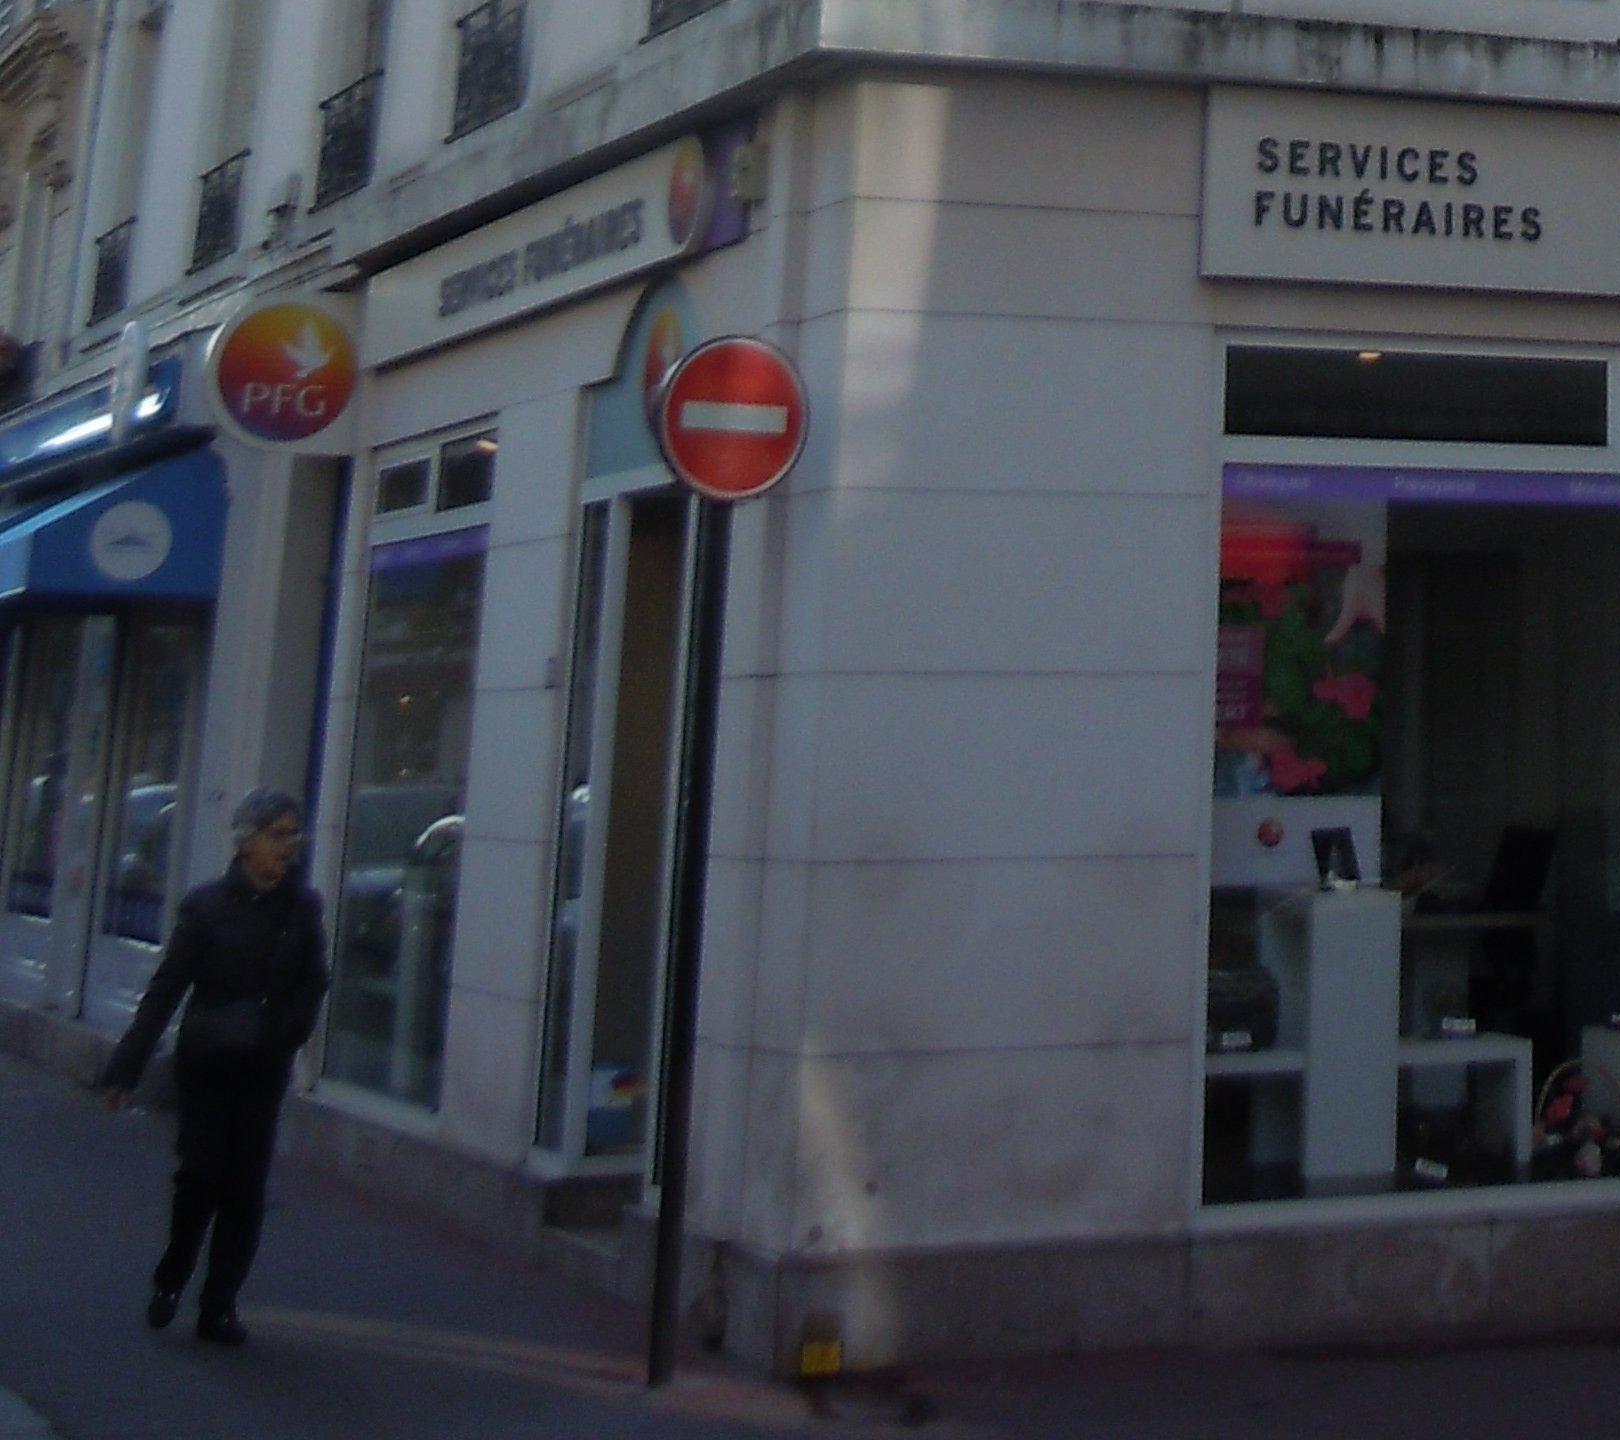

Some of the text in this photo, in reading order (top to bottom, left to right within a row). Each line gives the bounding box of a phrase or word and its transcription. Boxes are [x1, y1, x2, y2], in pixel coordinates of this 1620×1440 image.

[1257, 137, 1478, 186] SERVICES
[1254, 188, 1542, 241] FUNÉRAIRES
[243, 382, 327, 417] PFG
